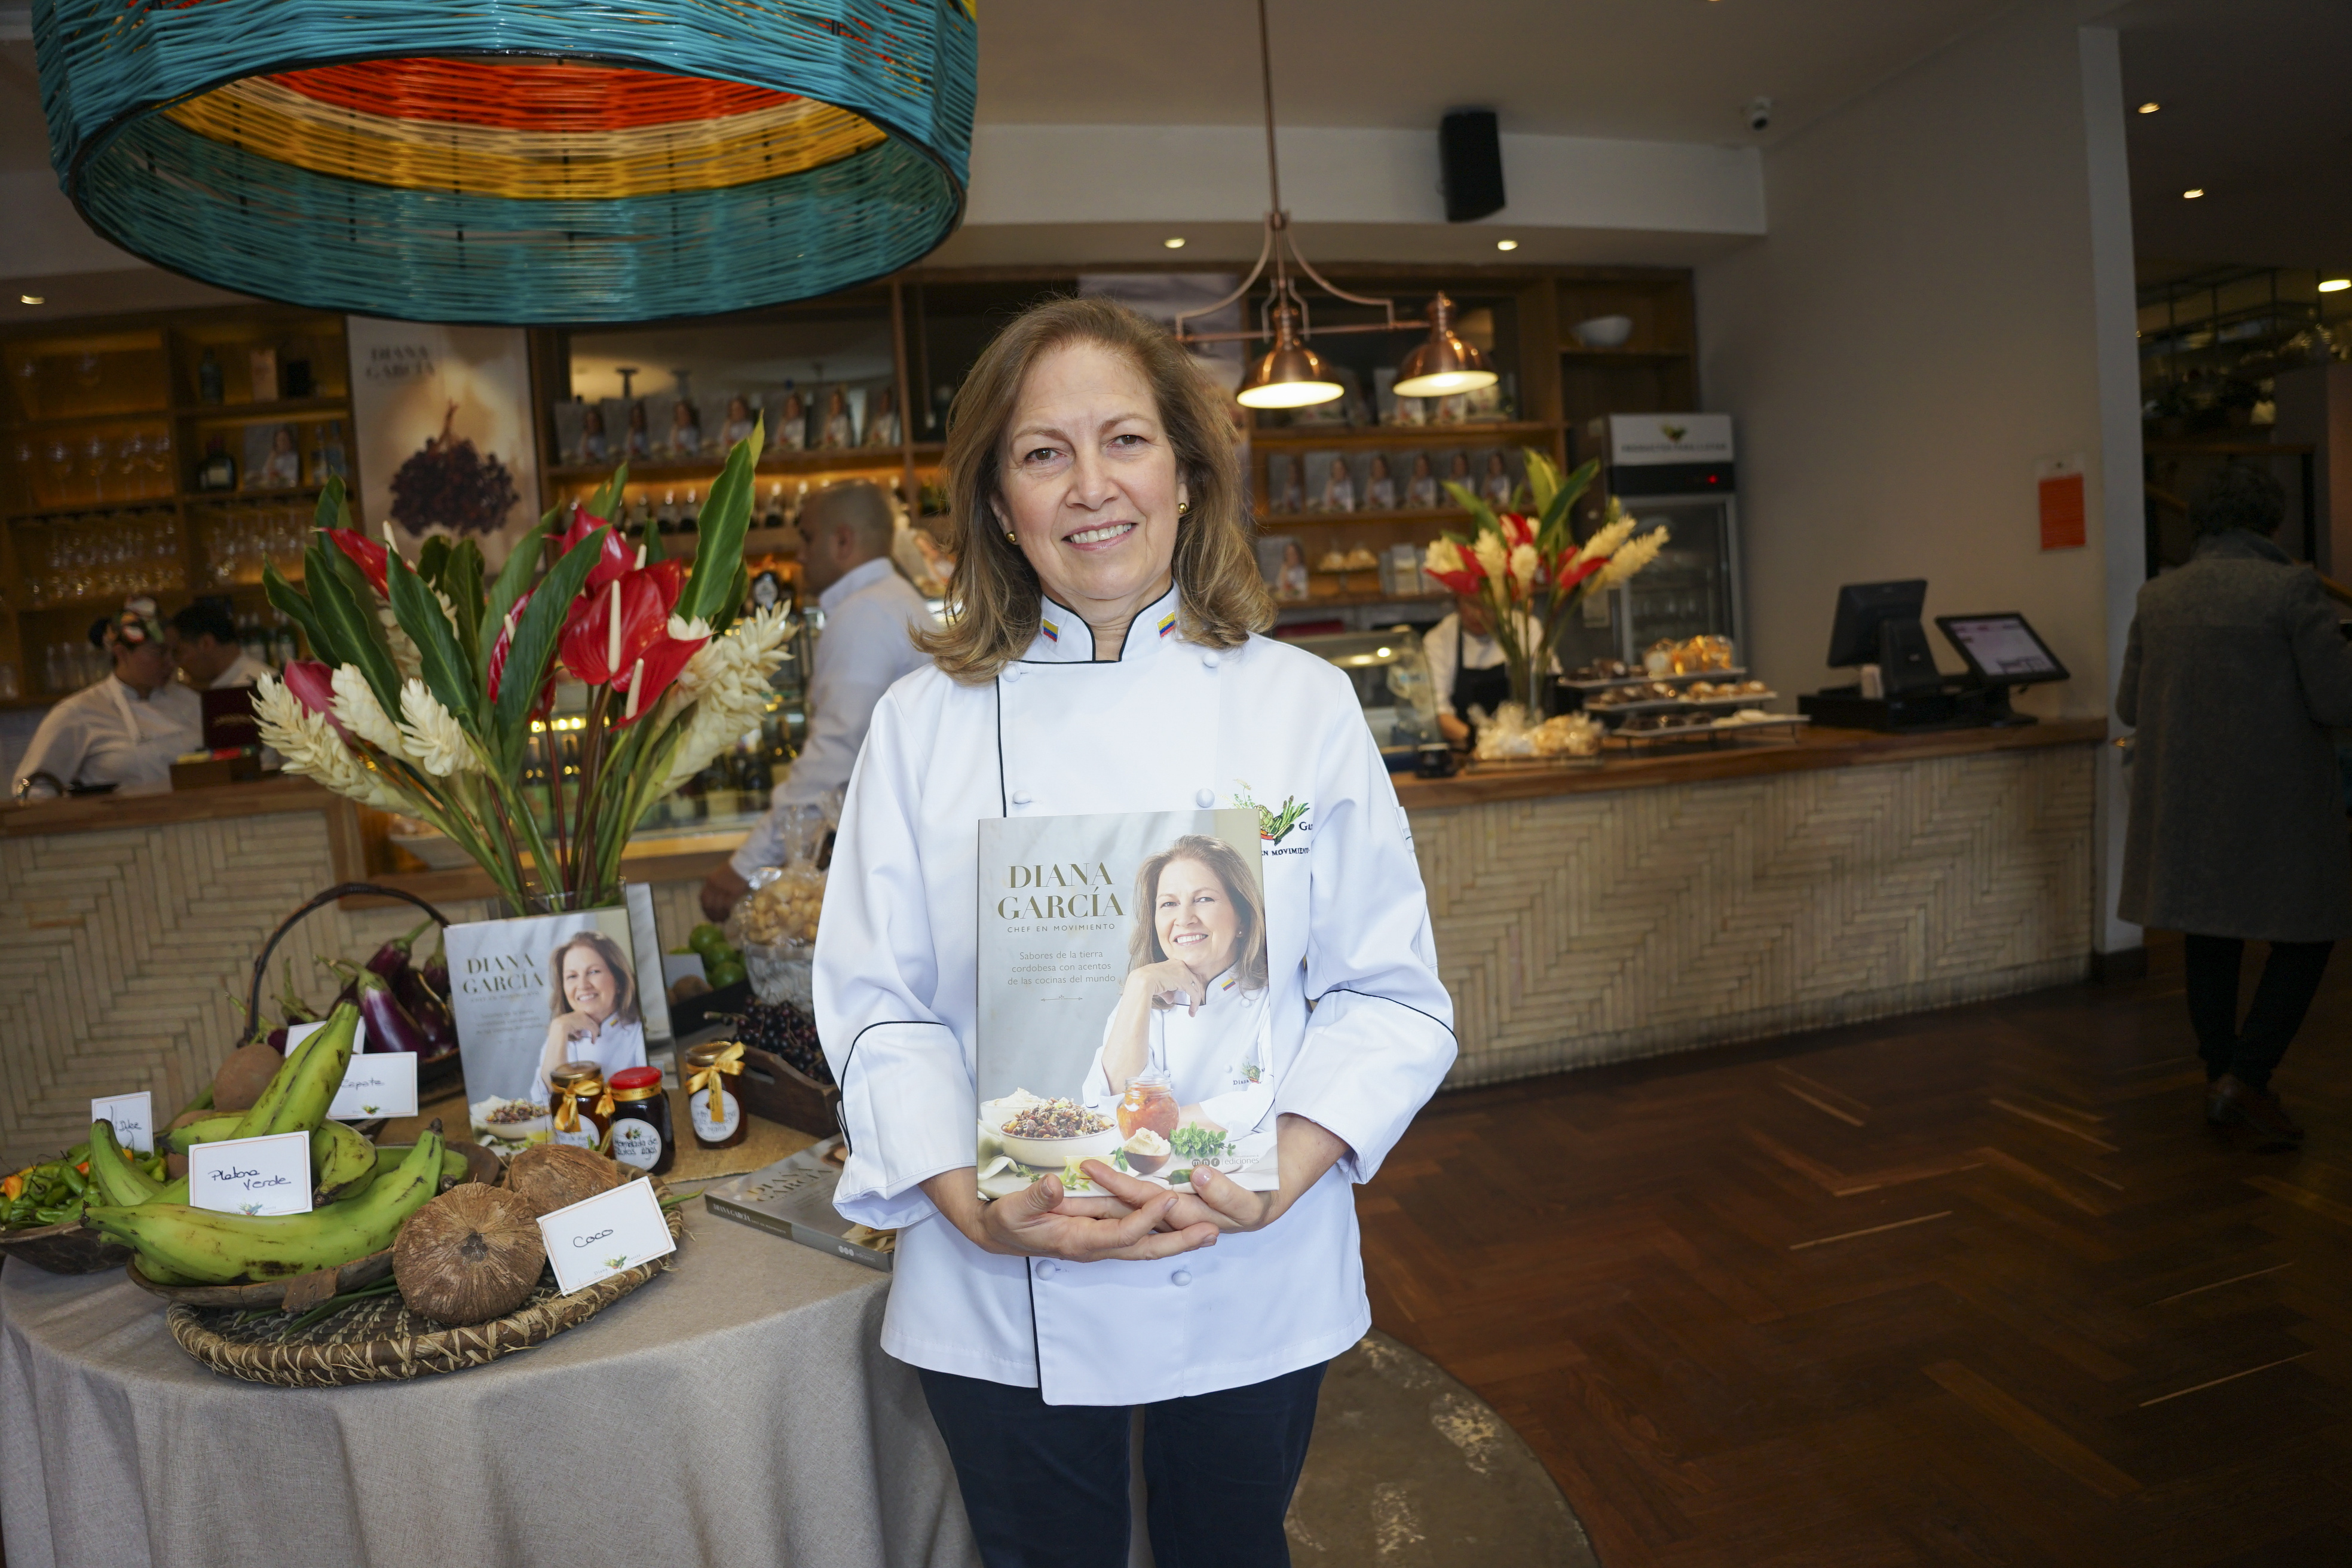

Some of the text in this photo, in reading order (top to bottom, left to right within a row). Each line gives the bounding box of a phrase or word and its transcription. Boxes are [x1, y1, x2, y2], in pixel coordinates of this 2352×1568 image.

[1008, 862, 1115, 889] DIANA
[998, 886, 1126, 920] GARCÍA
[467, 953, 535, 975] DIANA
[1019, 951, 1053, 960] Sabores
[1056, 951, 1067, 959] de
[1012, 964, 1056, 973] cordobesa
[1007, 977, 1018, 985] de
[1021, 976, 1032, 985] las
[1035, 976, 1067, 984] cocinas
[1086, 974, 1116, 982] mundo
[243, 1175, 291, 1190] Verde
[573, 1229, 614, 1248] Coco
